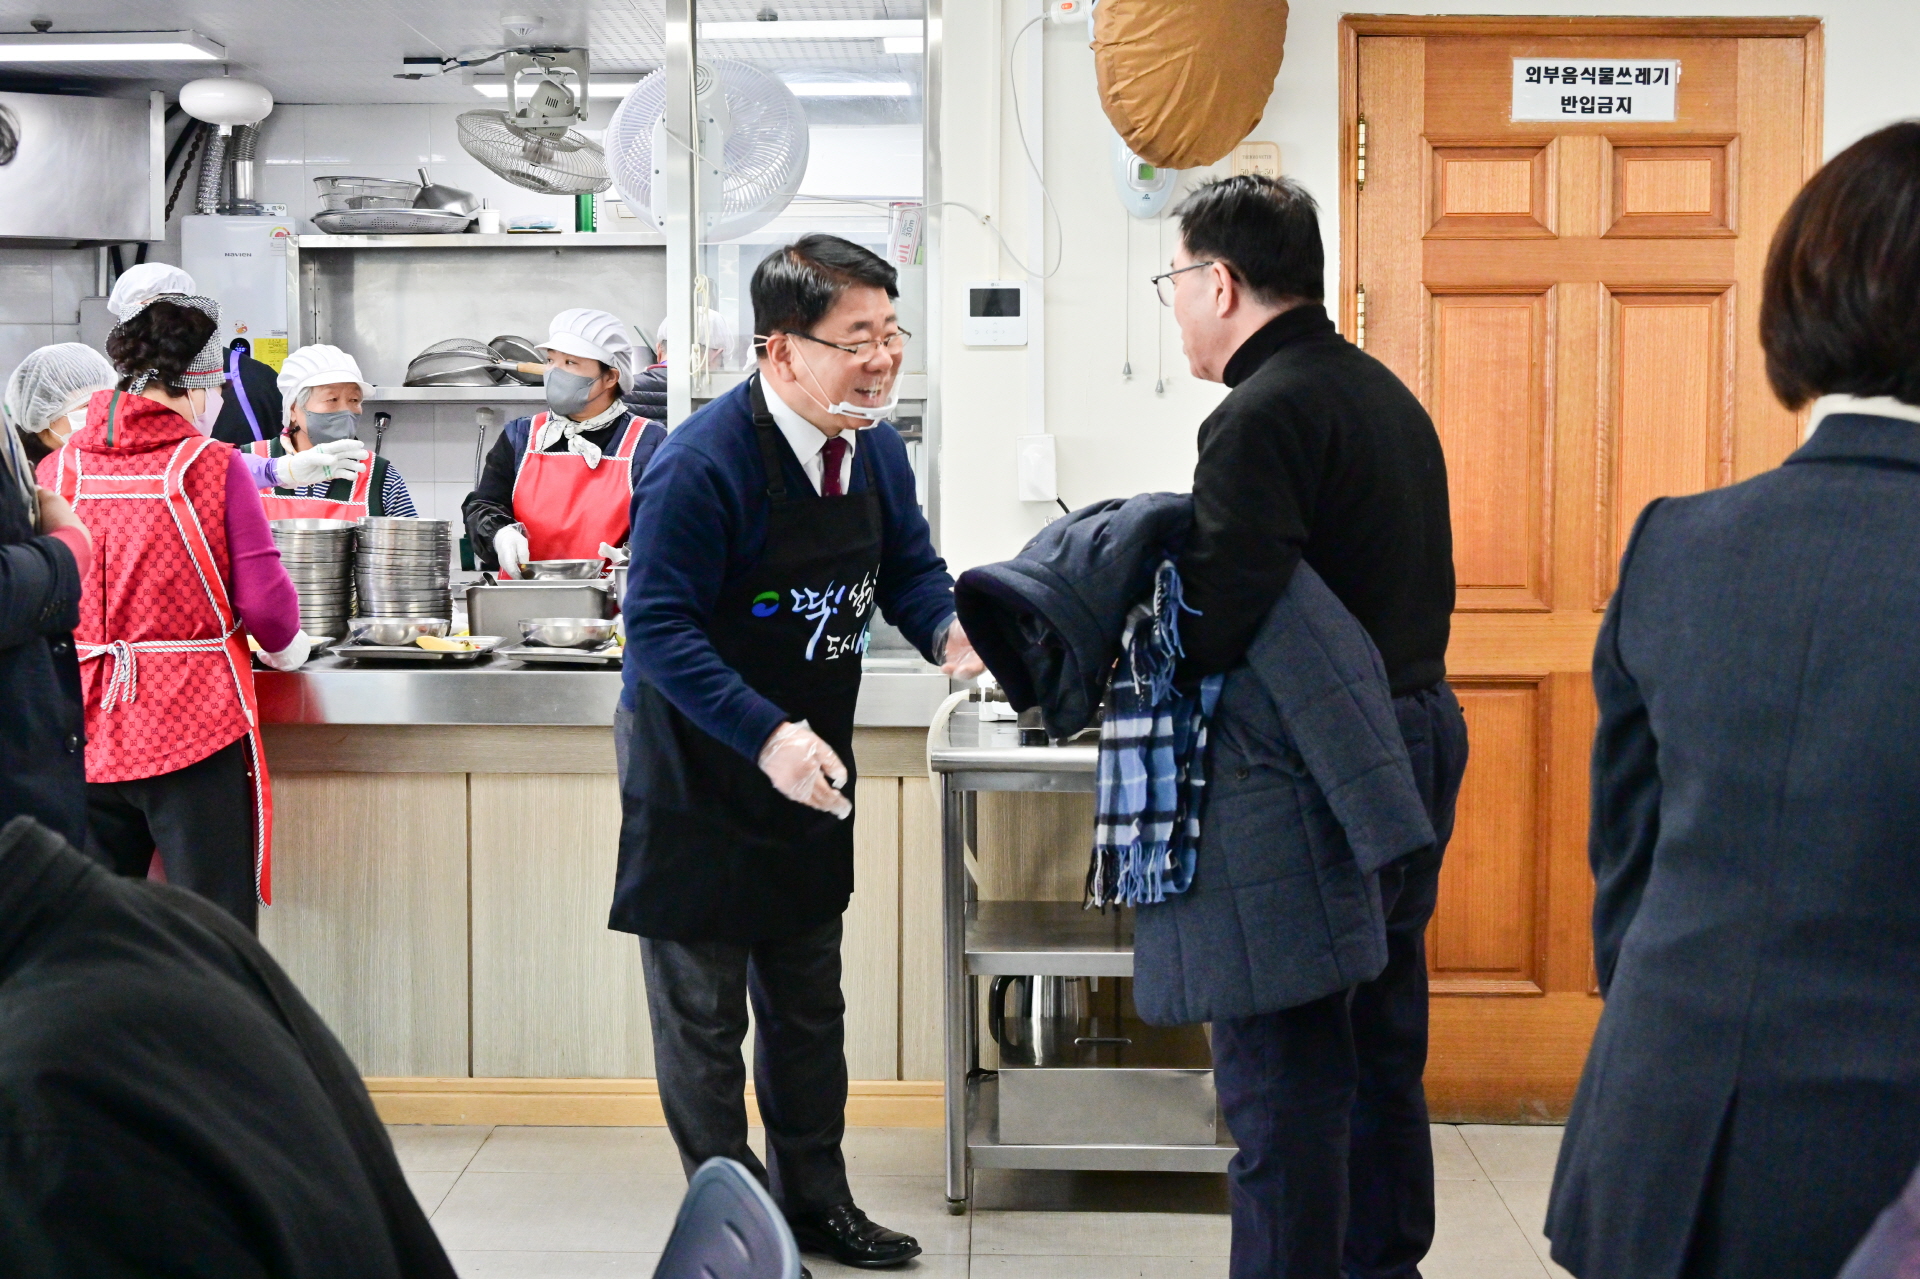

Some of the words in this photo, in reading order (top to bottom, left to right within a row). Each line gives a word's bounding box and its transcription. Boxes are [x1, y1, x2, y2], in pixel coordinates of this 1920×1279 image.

[1525, 66, 1669, 86] 외부음식물쓰레기
[1561, 96, 1632, 114] 반입금지
[896, 244, 911, 263] OIL
